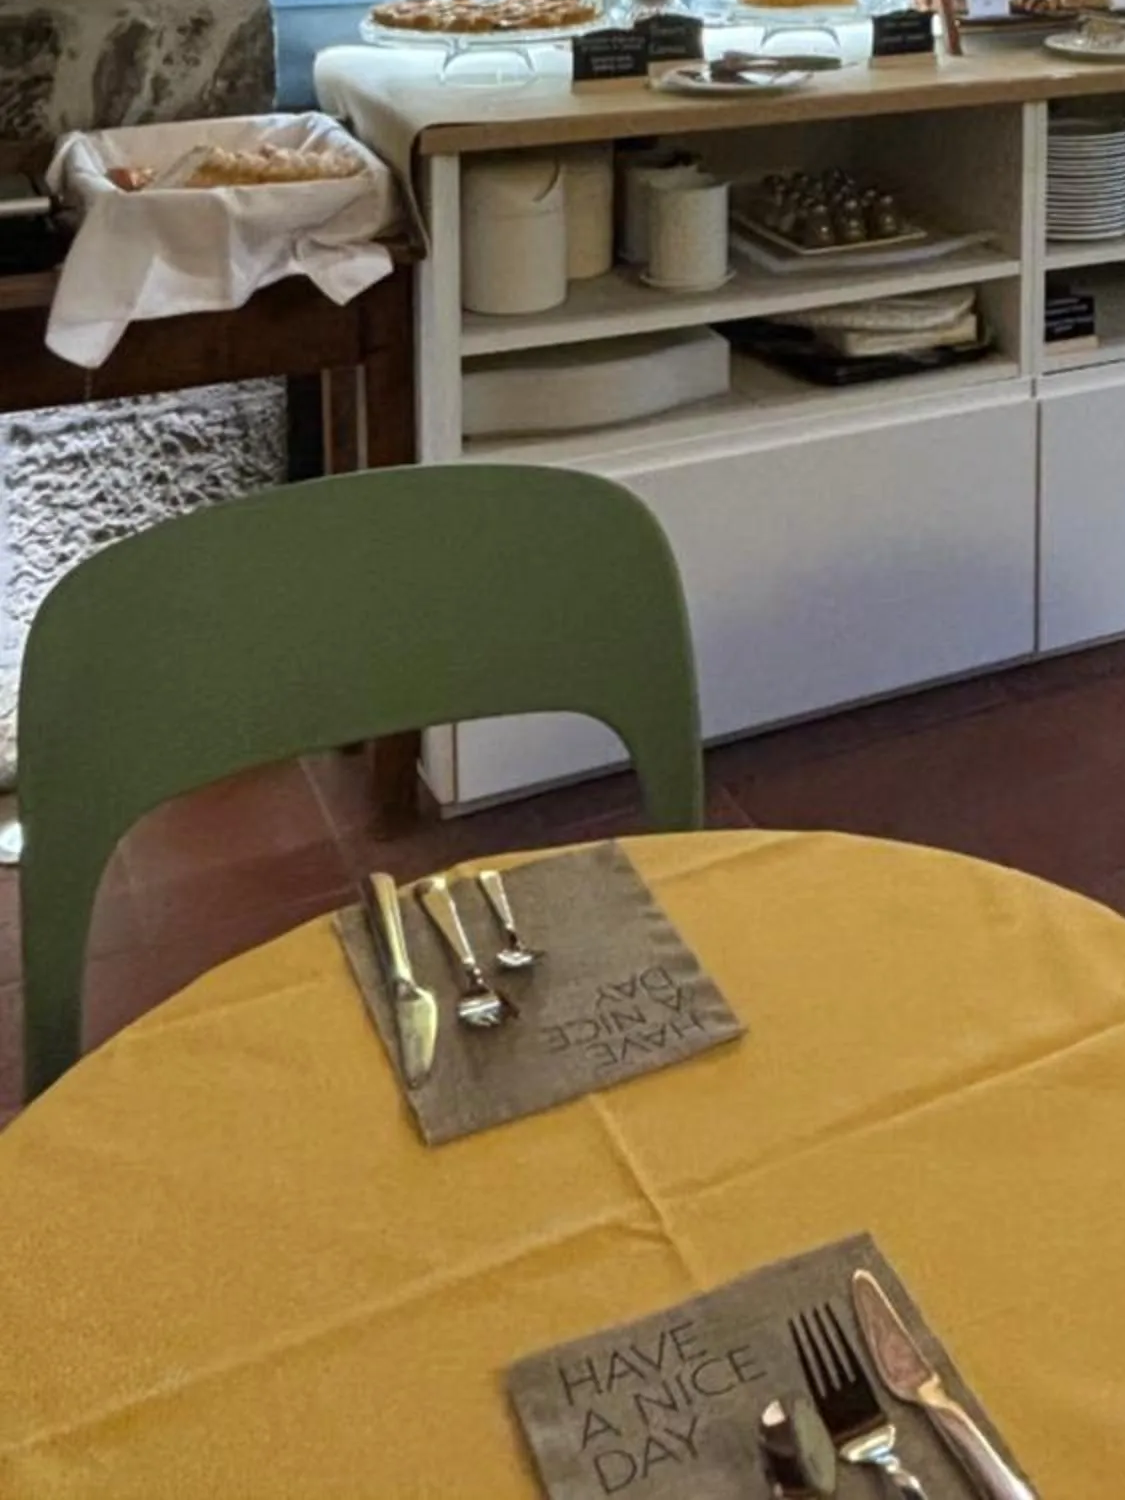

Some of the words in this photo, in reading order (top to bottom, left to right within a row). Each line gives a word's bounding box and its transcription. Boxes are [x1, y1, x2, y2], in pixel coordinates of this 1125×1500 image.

[596, 966, 674, 1007] DAY
[650, 987, 684, 1012] A
[543, 1004, 647, 1050] NICE
[585, 1006, 706, 1067] HAVE
[558, 1321, 707, 1406] HAVE
[580, 1408, 622, 1451] A
[633, 1344, 768, 1427] NICE
[593, 1417, 699, 1496] DAY
